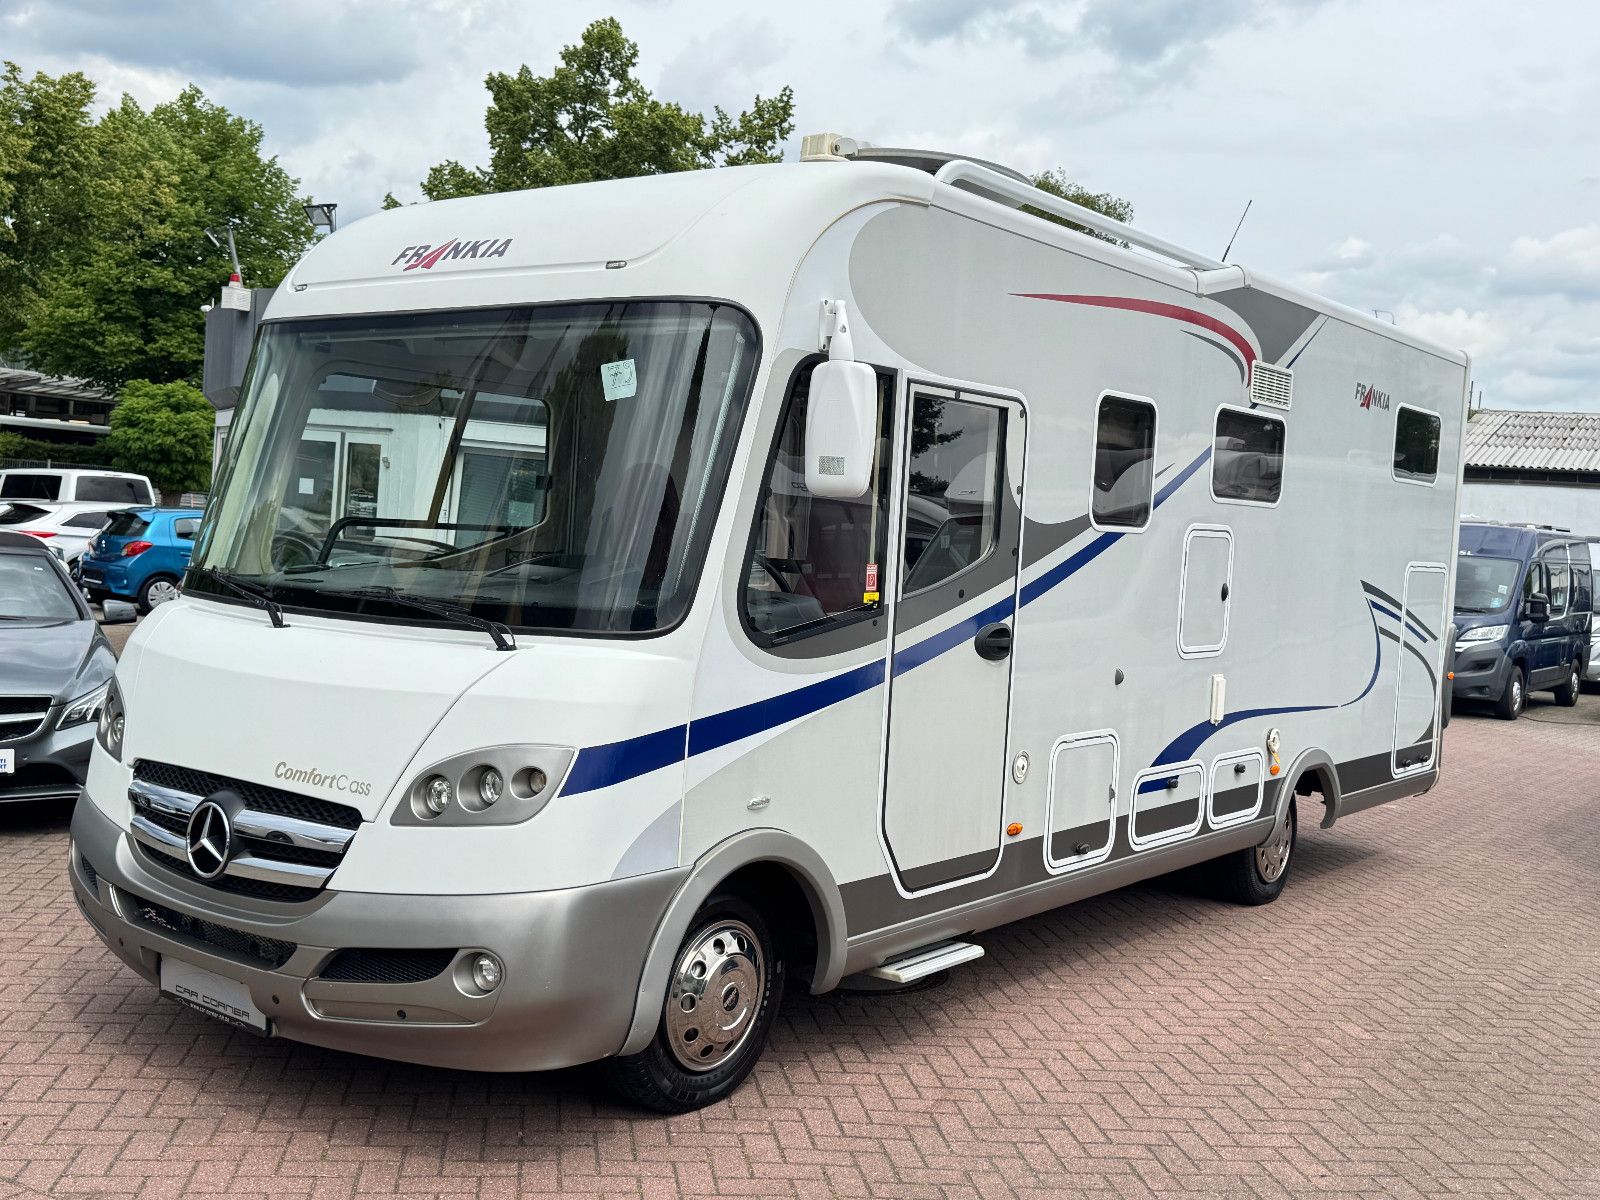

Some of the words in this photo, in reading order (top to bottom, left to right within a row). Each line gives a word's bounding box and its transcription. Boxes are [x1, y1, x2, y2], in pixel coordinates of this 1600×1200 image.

[391, 238, 513, 271] FRANKIA
[1355, 382, 1390, 411] FRANKIA
[175, 984, 199, 1000] CAR
[202, 994, 250, 1021] CORNER
